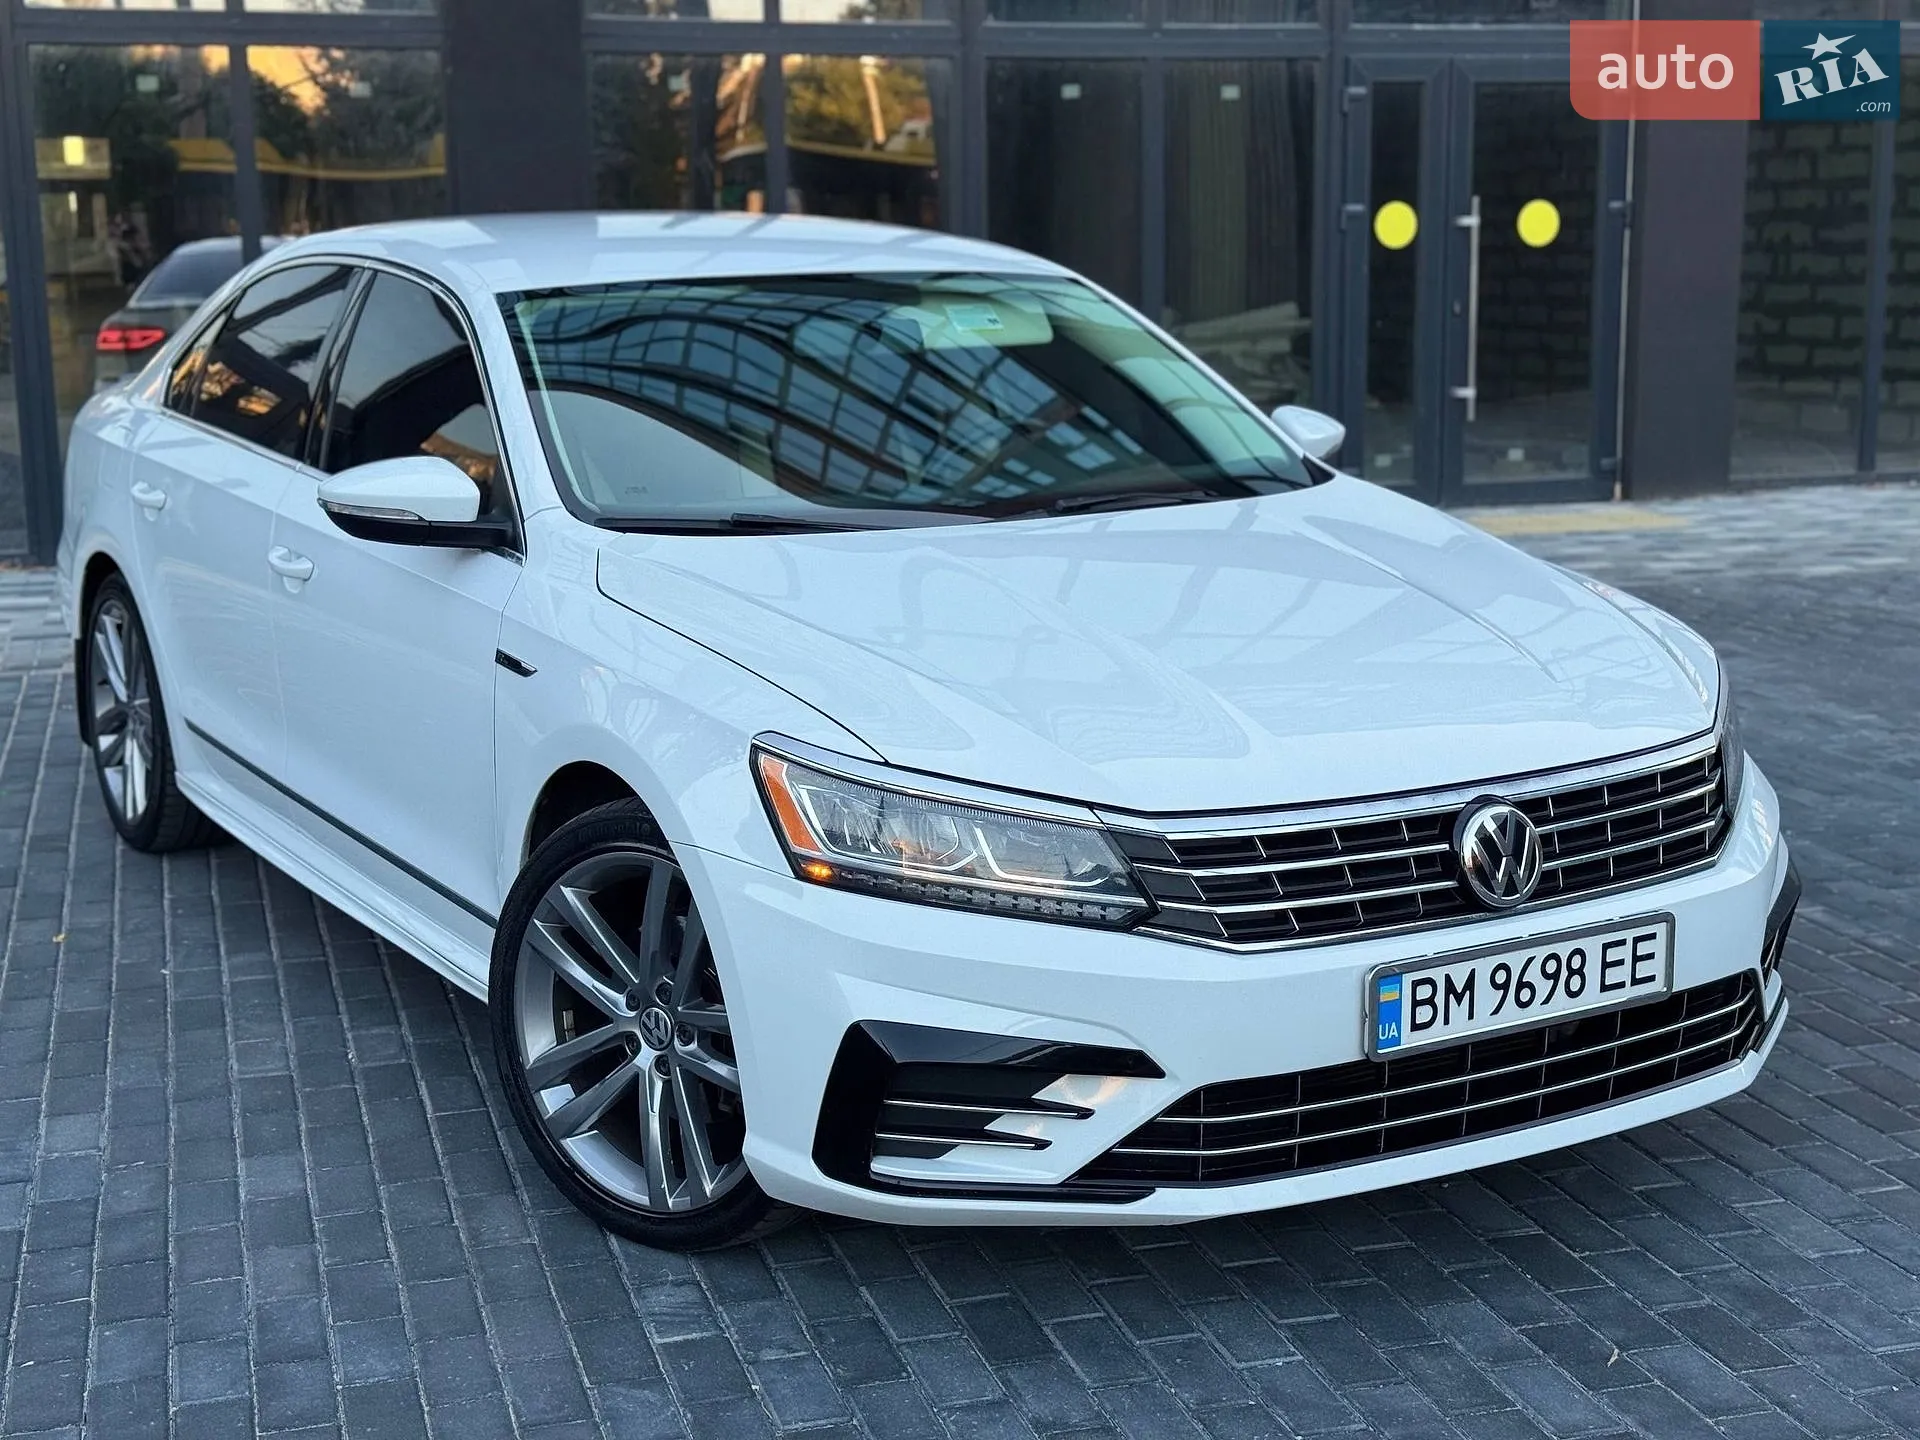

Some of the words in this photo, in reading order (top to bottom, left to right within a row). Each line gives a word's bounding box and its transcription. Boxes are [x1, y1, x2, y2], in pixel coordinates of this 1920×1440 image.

[1463, 805, 1541, 905] VW
[1378, 1023, 1399, 1040] UA
[1410, 968, 1476, 1032] BM
[1489, 948, 1587, 1016] 9698
[1600, 932, 1657, 993] EE
